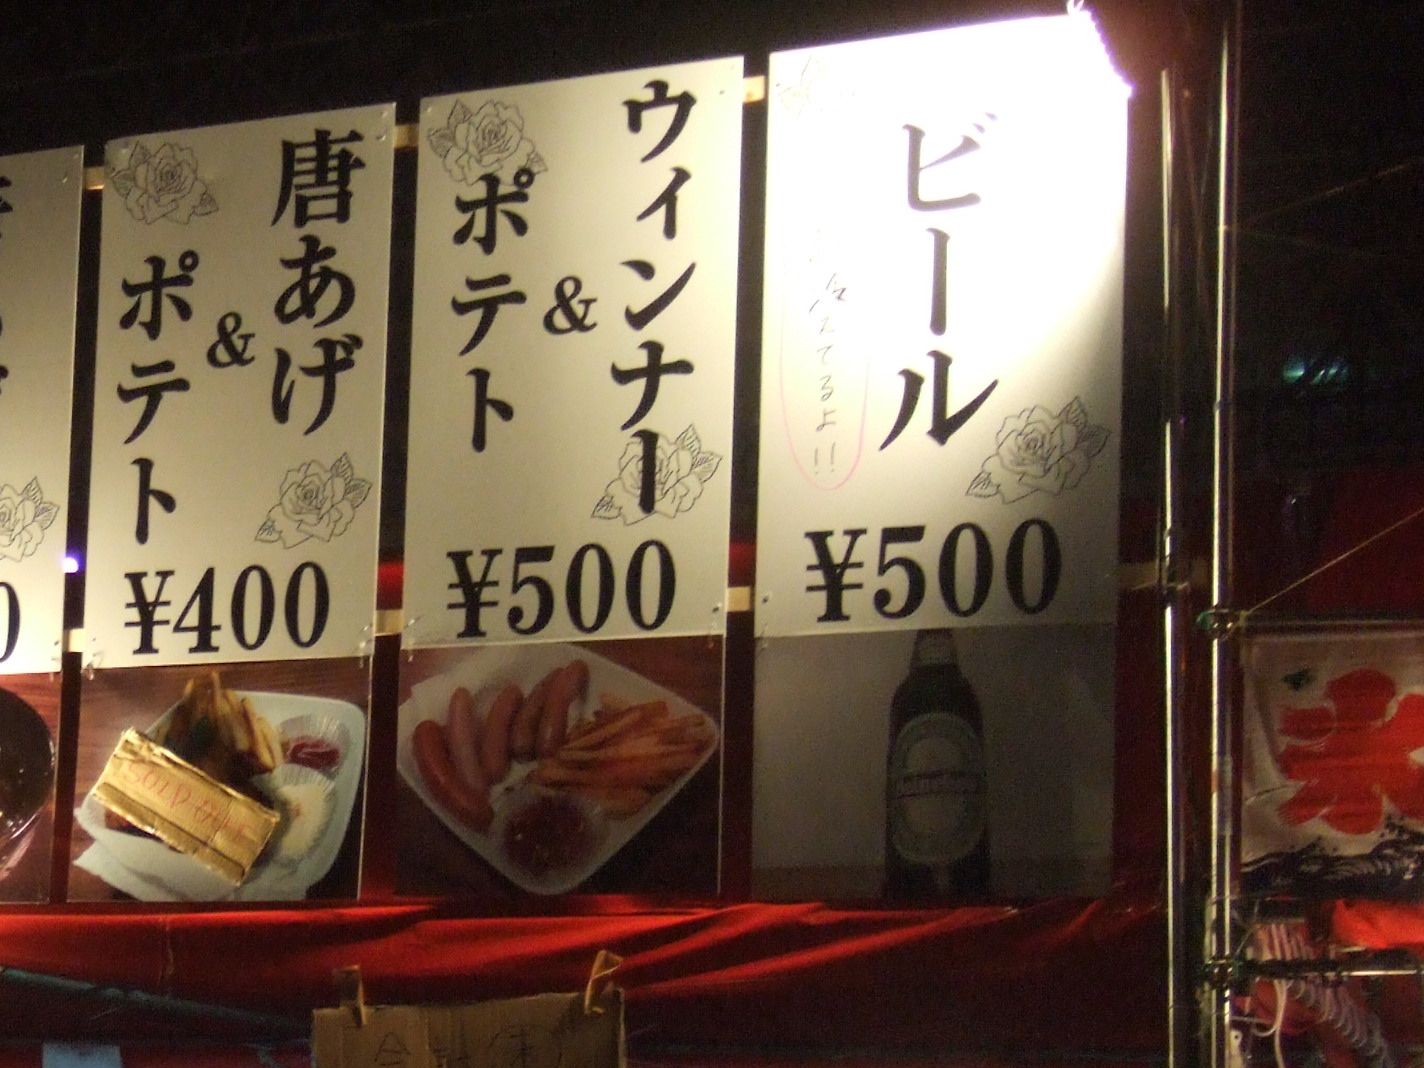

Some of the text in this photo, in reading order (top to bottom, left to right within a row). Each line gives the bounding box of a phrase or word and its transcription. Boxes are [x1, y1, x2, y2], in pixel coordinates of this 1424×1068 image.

[206, 310, 257, 370] &
[271, 127, 369, 437] 唐あげ
[450, 166, 536, 453] ポテト
[542, 275, 598, 335] &
[610, 79, 698, 516] ウィンナー
[878, 110, 1000, 451] ビール
[116, 251, 202, 545] ポテト
[123, 560, 331, 656] ¥400
[446, 538, 677, 640] ¥500
[803, 517, 1063, 626] ¥500
